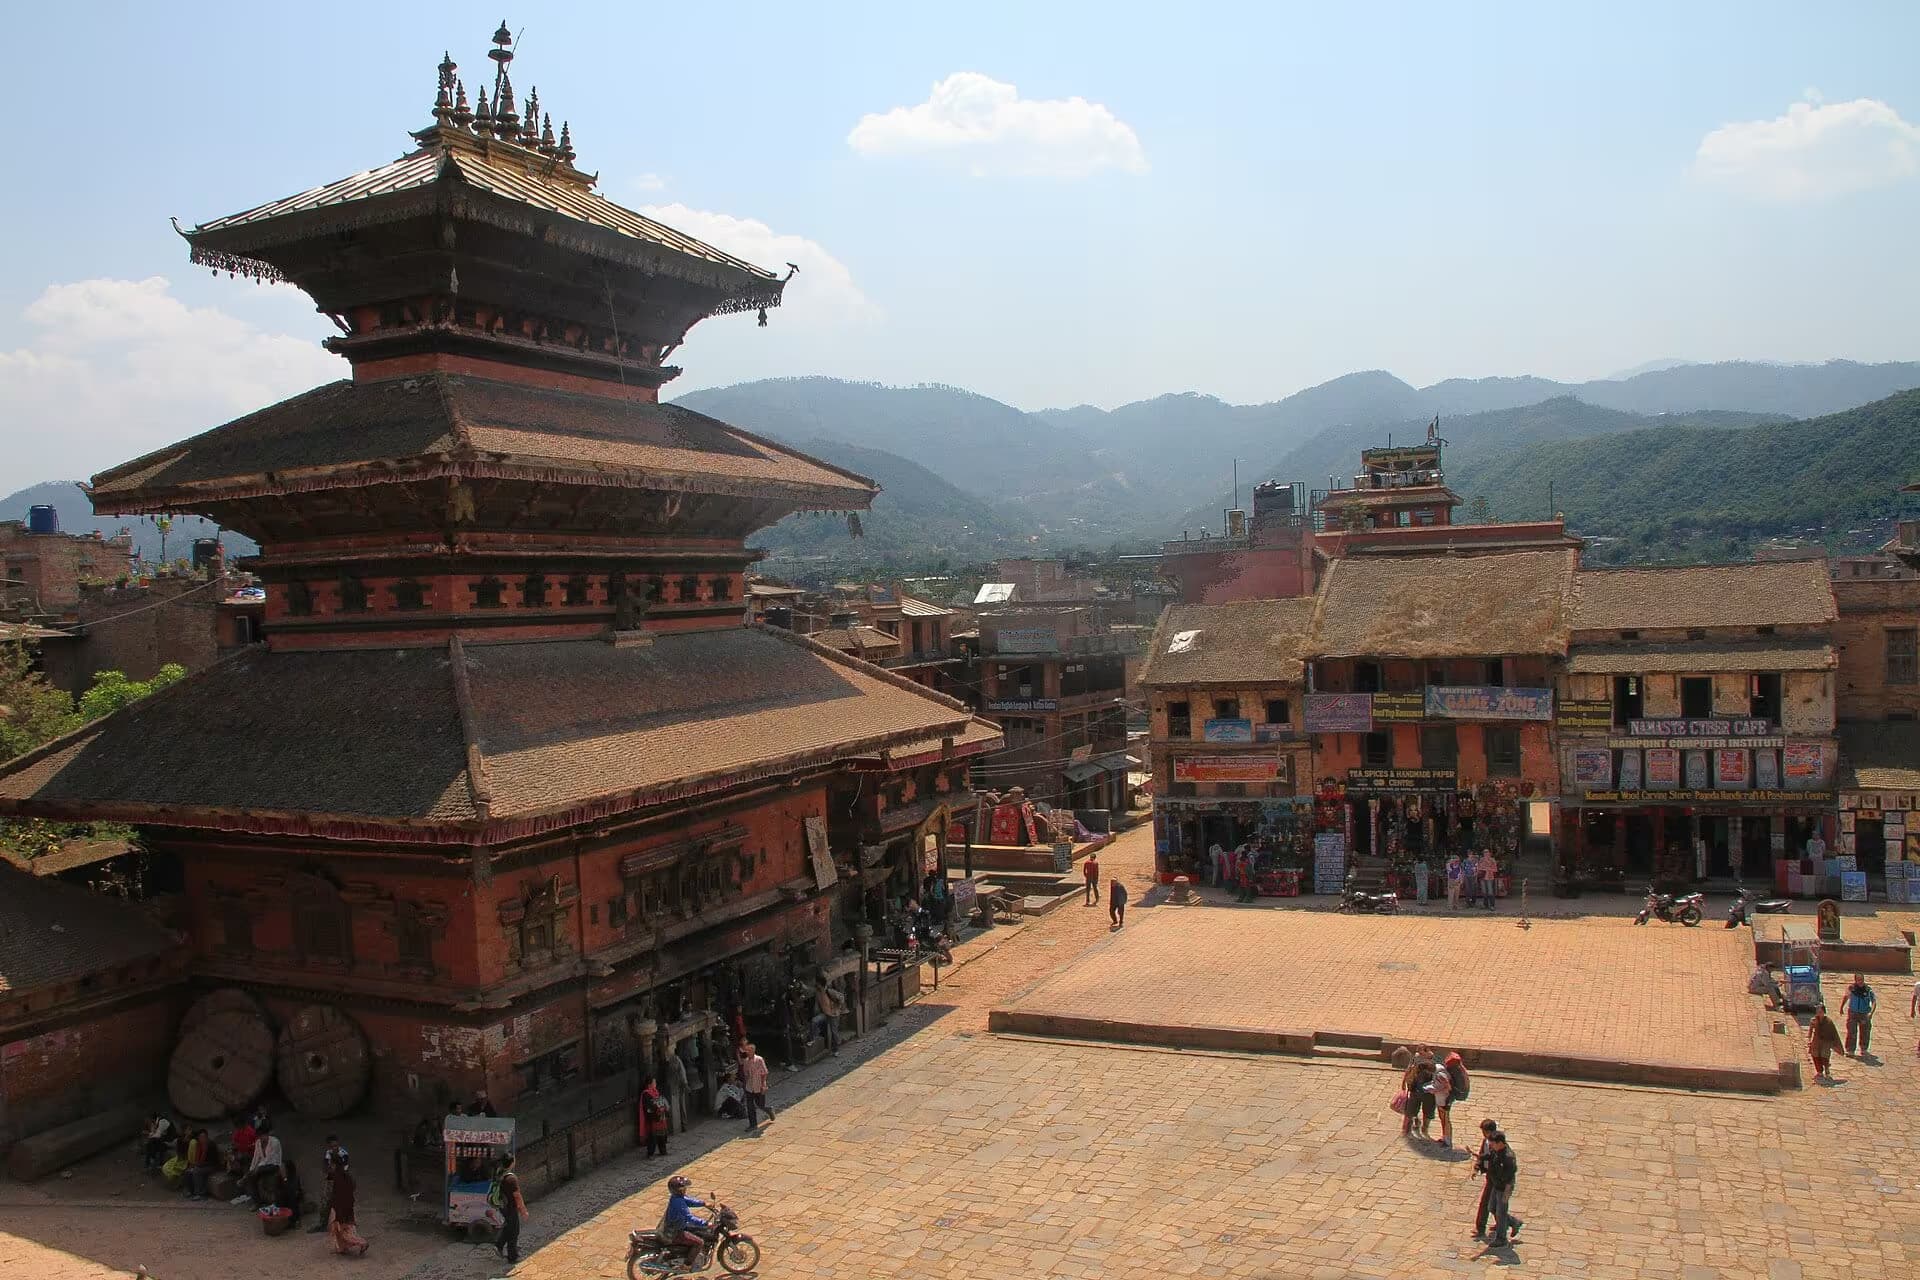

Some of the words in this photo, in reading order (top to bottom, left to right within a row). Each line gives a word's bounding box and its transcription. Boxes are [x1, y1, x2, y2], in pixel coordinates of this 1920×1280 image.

[1630, 720, 1687, 735] NAMASTE
[1690, 720, 1731, 735] CYBER
[1734, 720, 1768, 735] CAFE
[1609, 739, 1667, 748] MAINPOINT
[1669, 739, 1726, 748] COMPUTER
[1728, 738, 1784, 748] INSTITUTE
